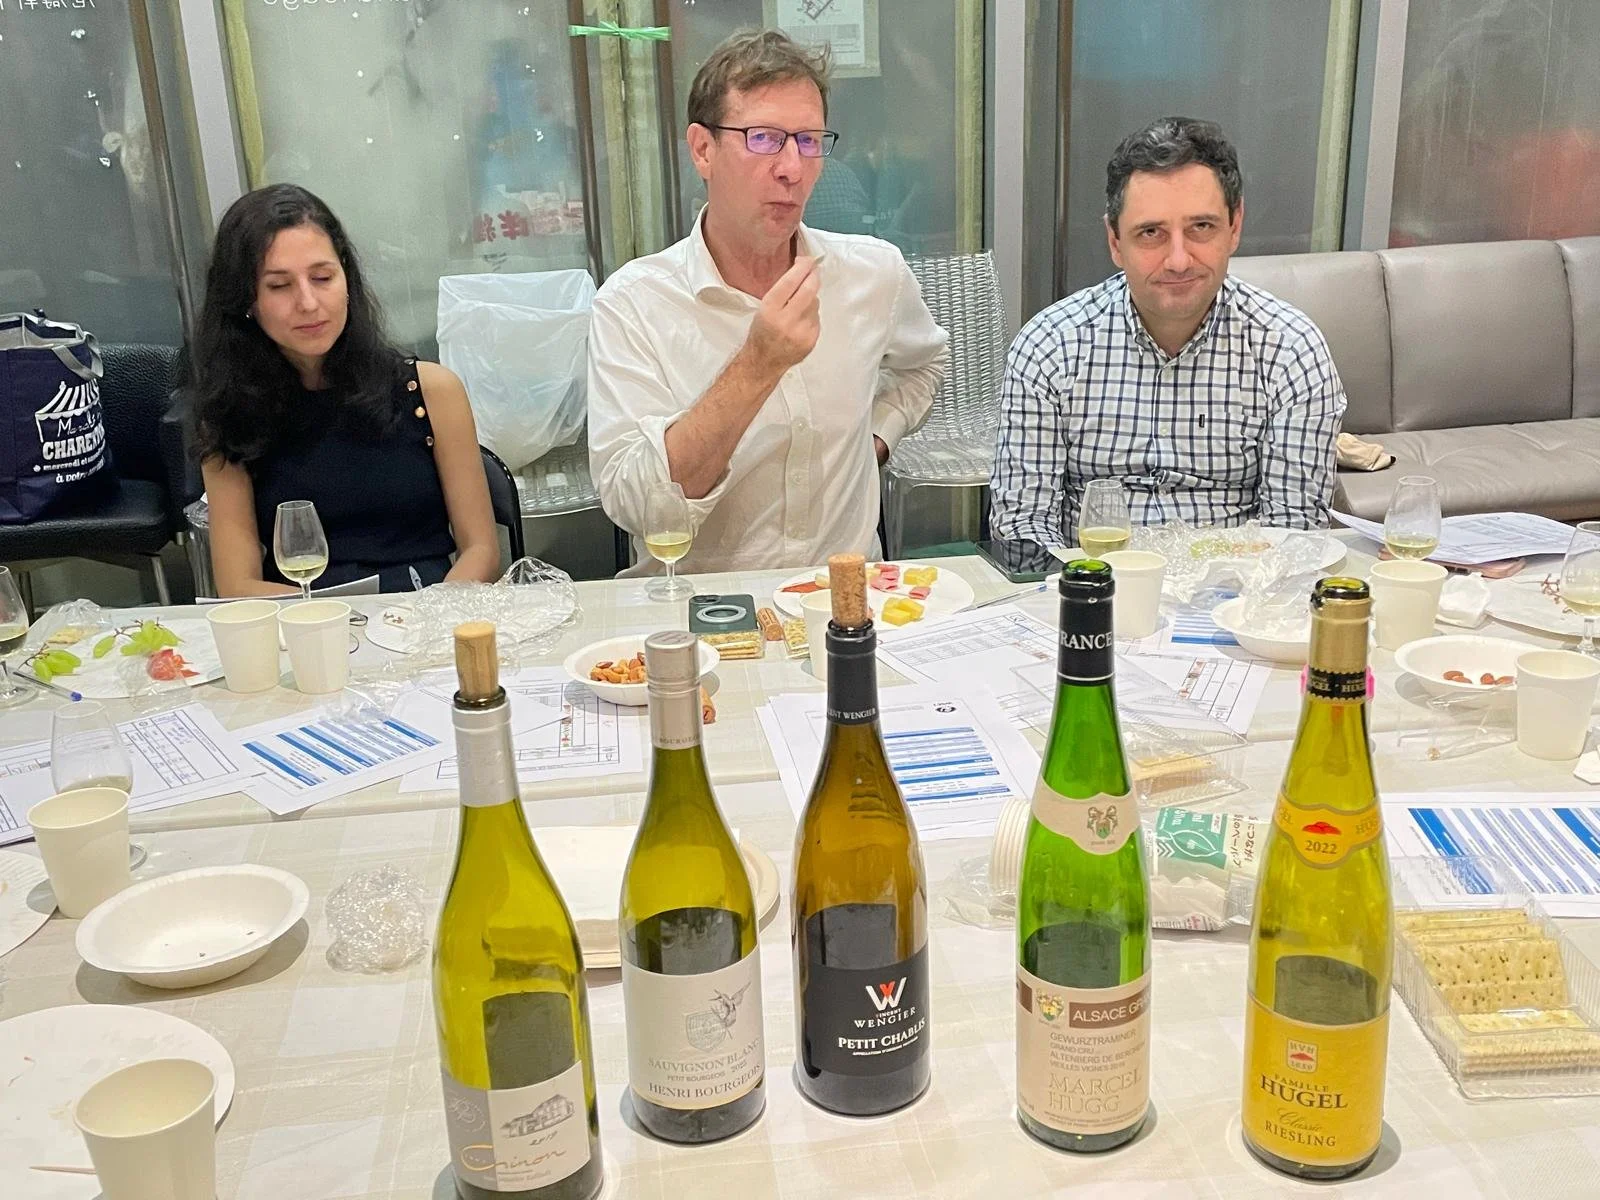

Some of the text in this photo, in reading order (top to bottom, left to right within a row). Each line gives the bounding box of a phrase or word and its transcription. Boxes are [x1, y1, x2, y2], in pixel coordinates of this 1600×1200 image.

[1059, 631, 1113, 649] RANCE
[1311, 682, 1331, 692] GEL
[1305, 840, 1337, 855] 2022
[854, 1007, 916, 1028] WENGIER
[1072, 1008, 1127, 1022] ALSACE
[838, 1037, 878, 1049] PETIT
[880, 1017, 926, 1047] CHABLIS
[648, 1038, 760, 1073] SAUVIGNON BLANC
[649, 1063, 761, 1098] HENRI BOURGEOIS
[1050, 1068, 1142, 1095] MARCEL
[1260, 1074, 1349, 1109] HUGEL
[1275, 1073, 1329, 1092] FAMILLE
[1050, 1091, 1120, 1114] HUGG
[1264, 1120, 1337, 1147] RIESLING
